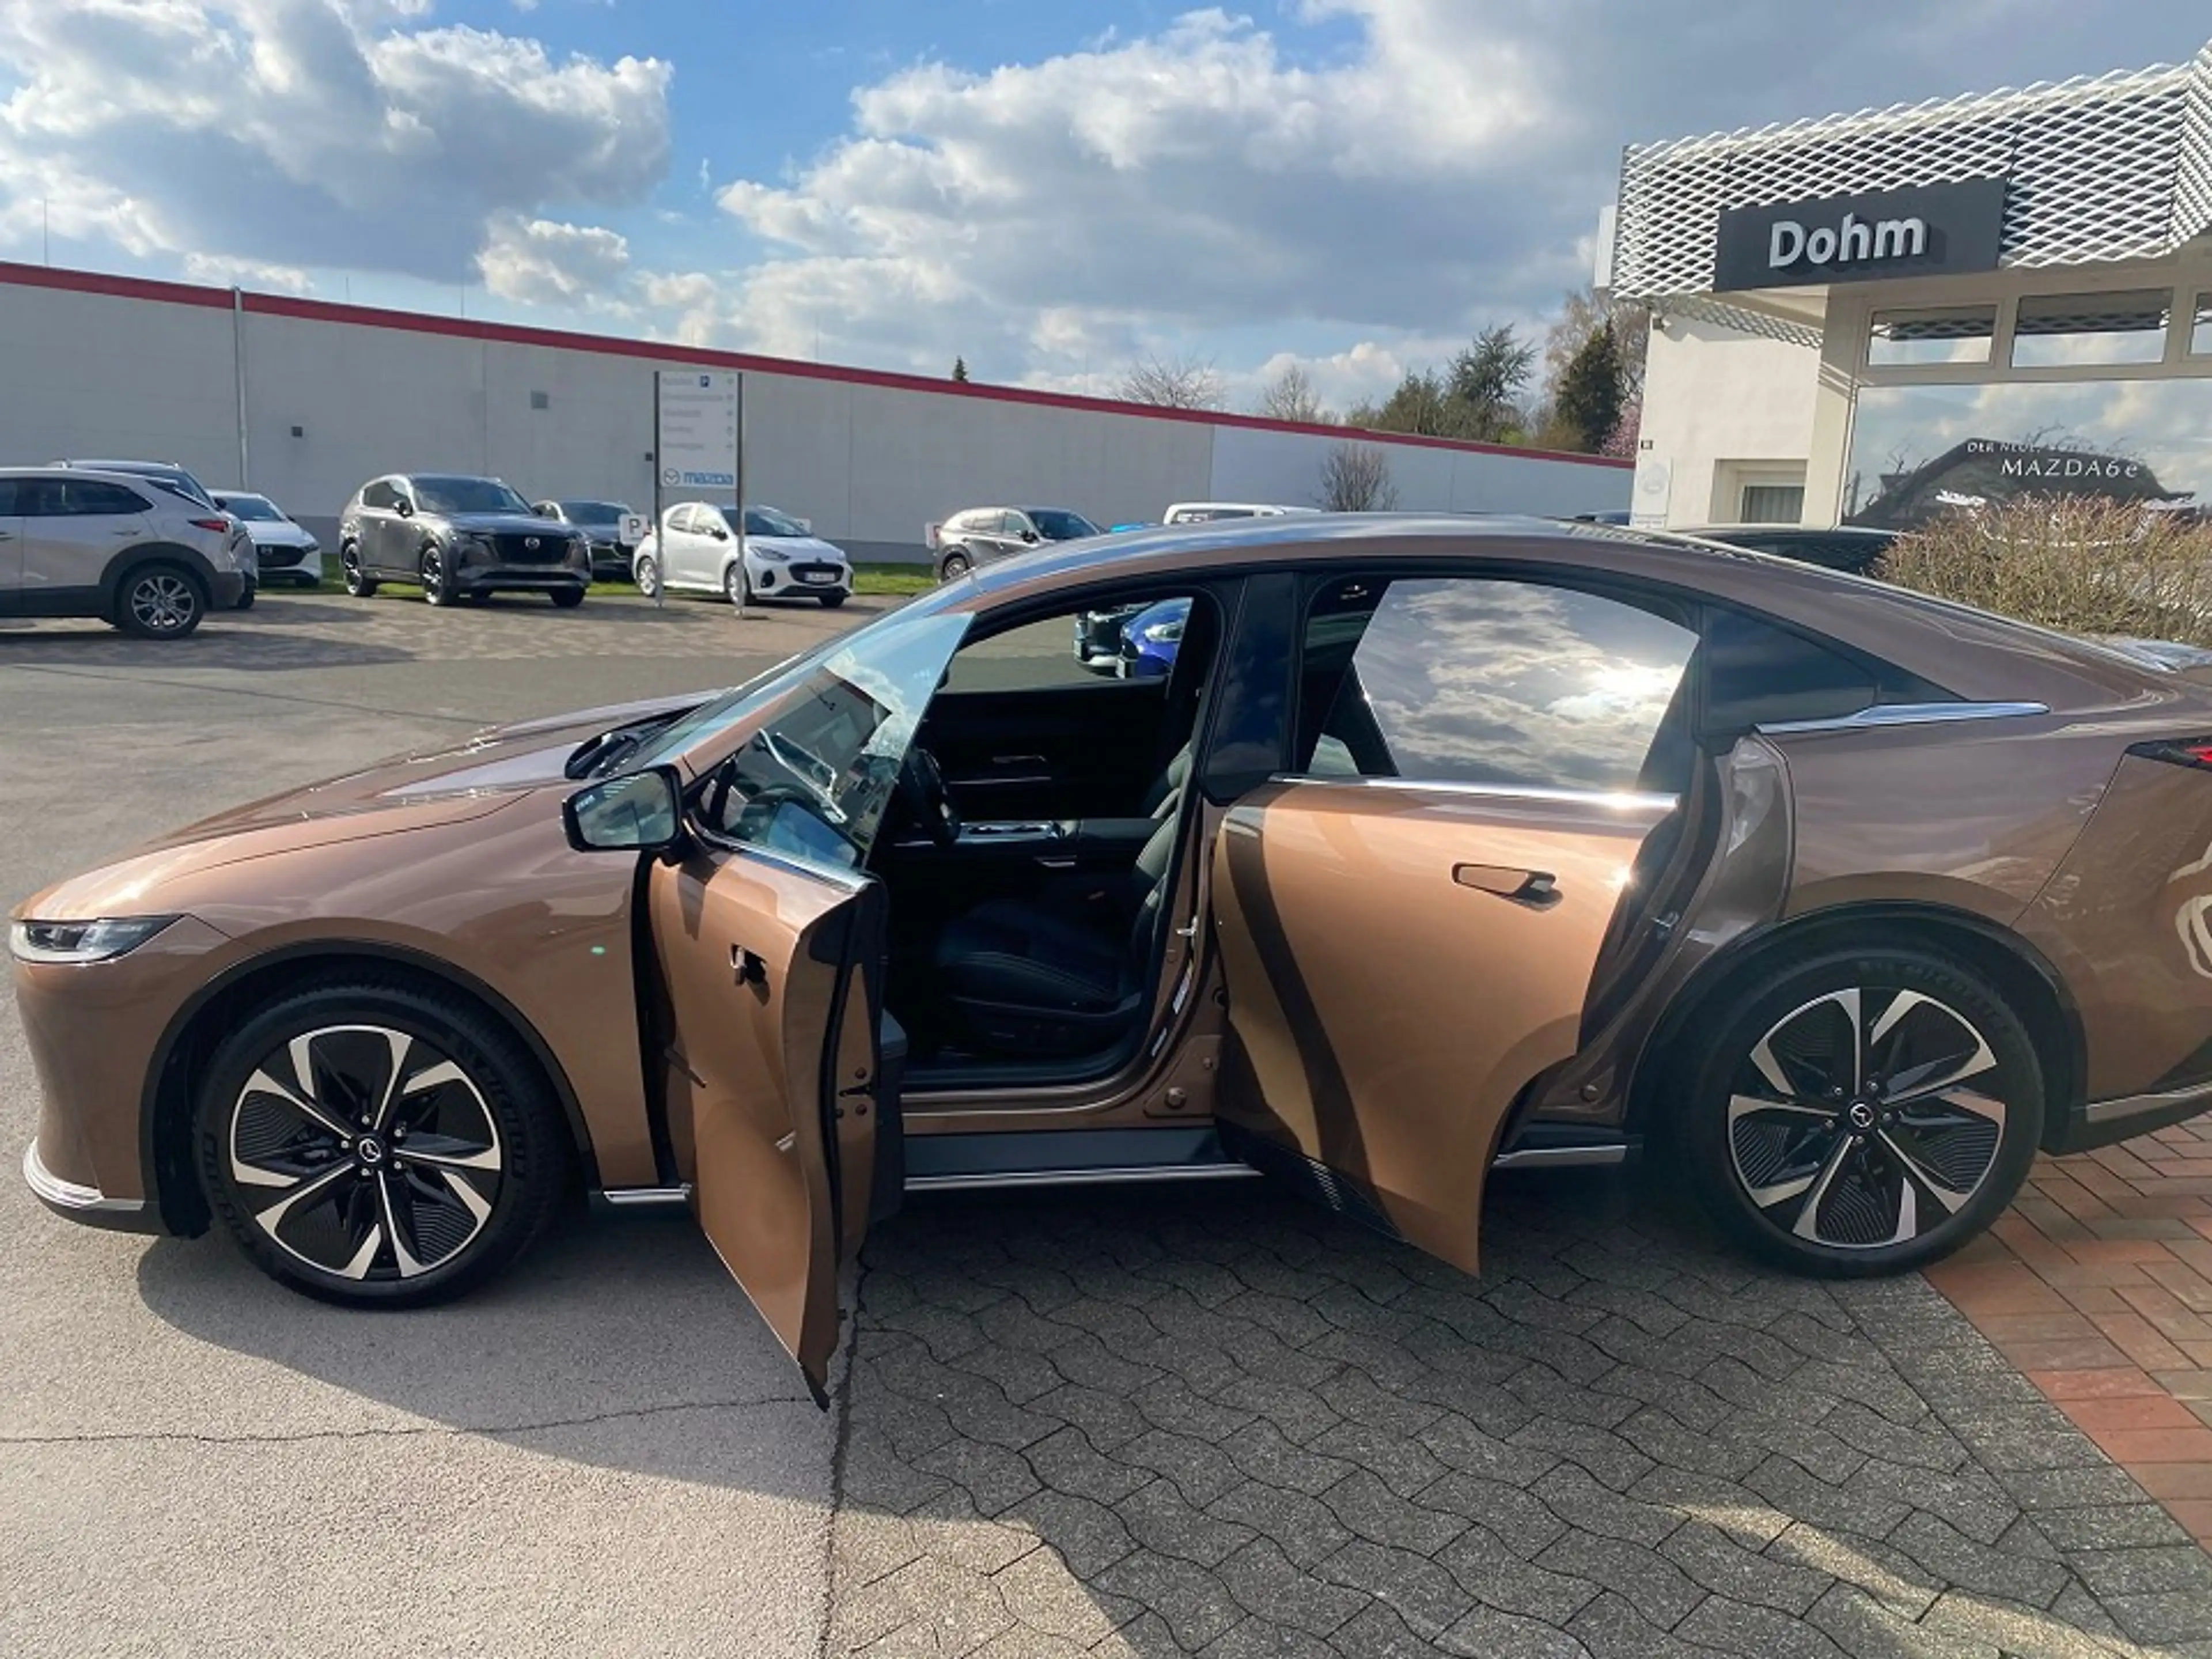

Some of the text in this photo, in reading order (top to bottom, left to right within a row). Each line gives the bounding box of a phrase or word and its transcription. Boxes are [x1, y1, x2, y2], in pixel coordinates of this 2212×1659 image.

[1768, 212, 1925, 267] Dohm
[1967, 442, 1994, 453] DER
[2000, 458, 2138, 478] MAZDA6e
[684, 472, 733, 484] mazda
[628, 518, 641, 534] P
